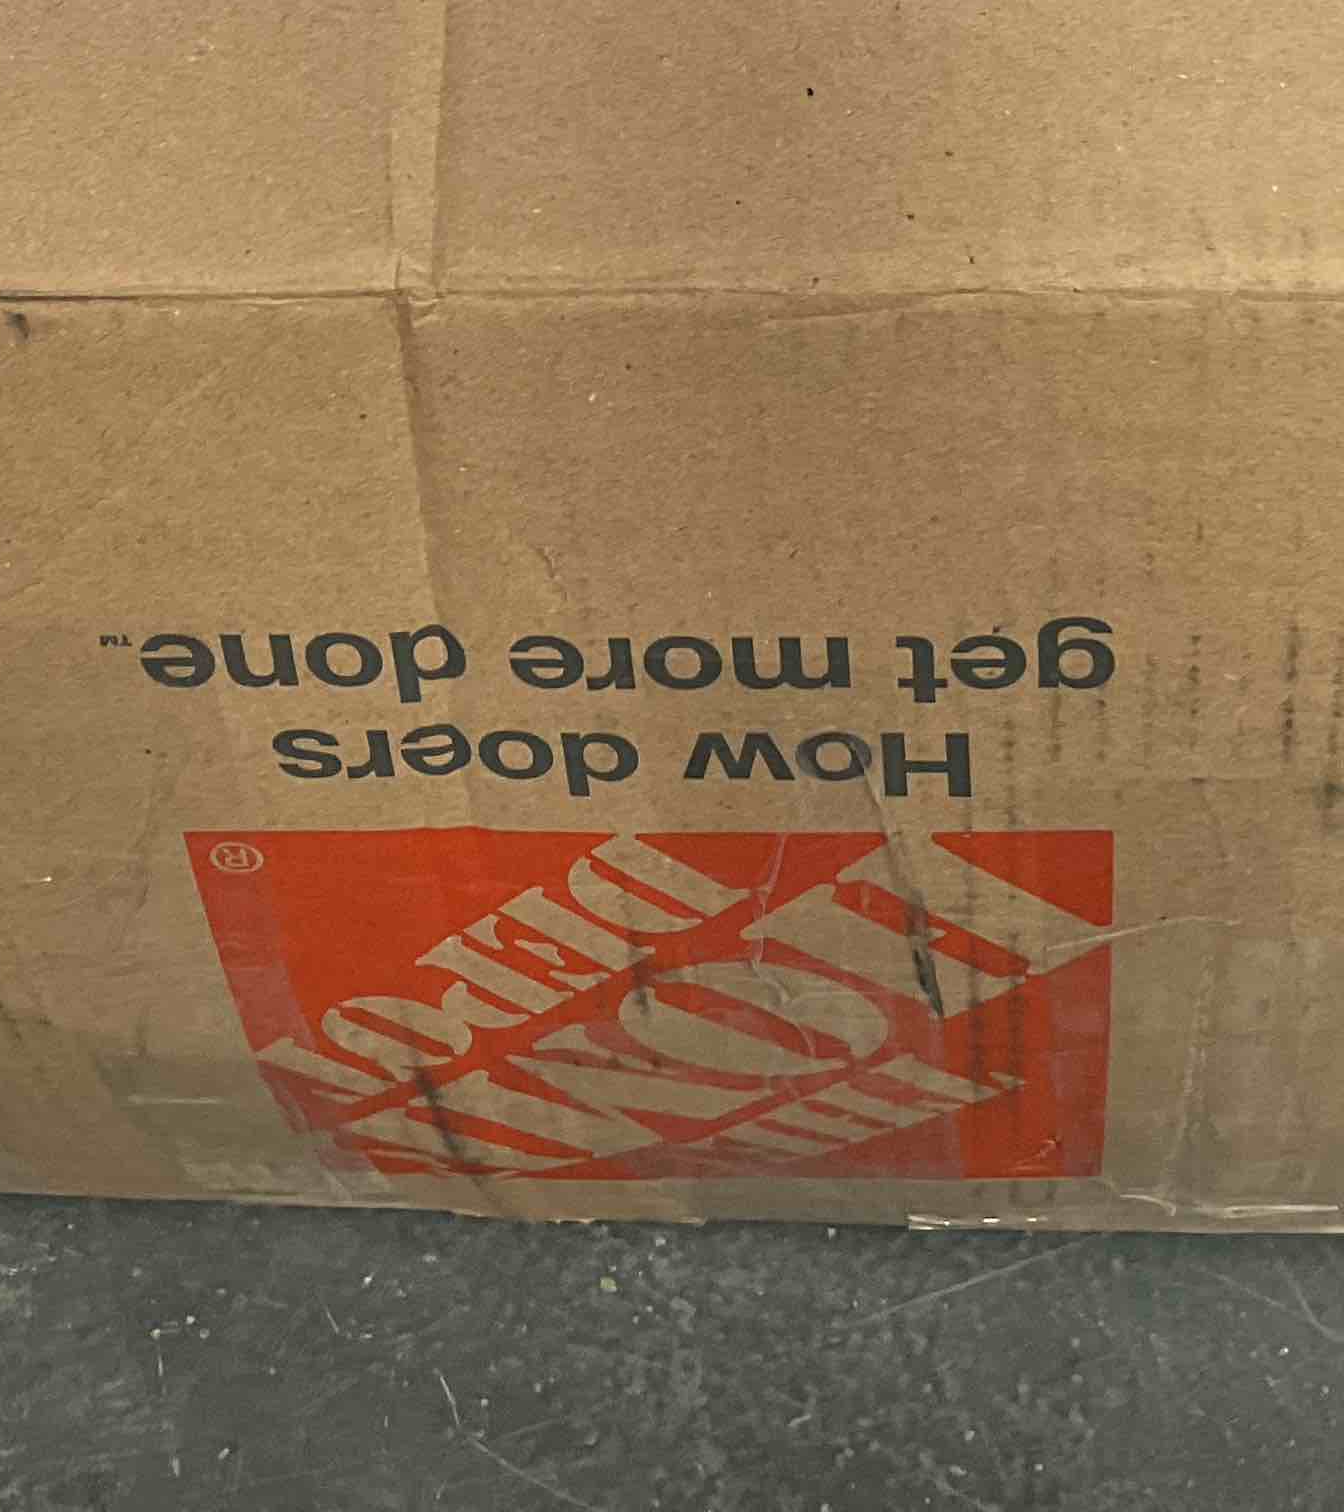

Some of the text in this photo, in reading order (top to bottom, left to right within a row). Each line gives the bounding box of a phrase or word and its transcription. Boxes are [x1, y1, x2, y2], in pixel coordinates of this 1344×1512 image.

[509, 635, 849, 693] more
[897, 617, 1114, 704] get
[272, 728, 972, 799] How doers
[254, 833, 750, 1106] DEPOT
